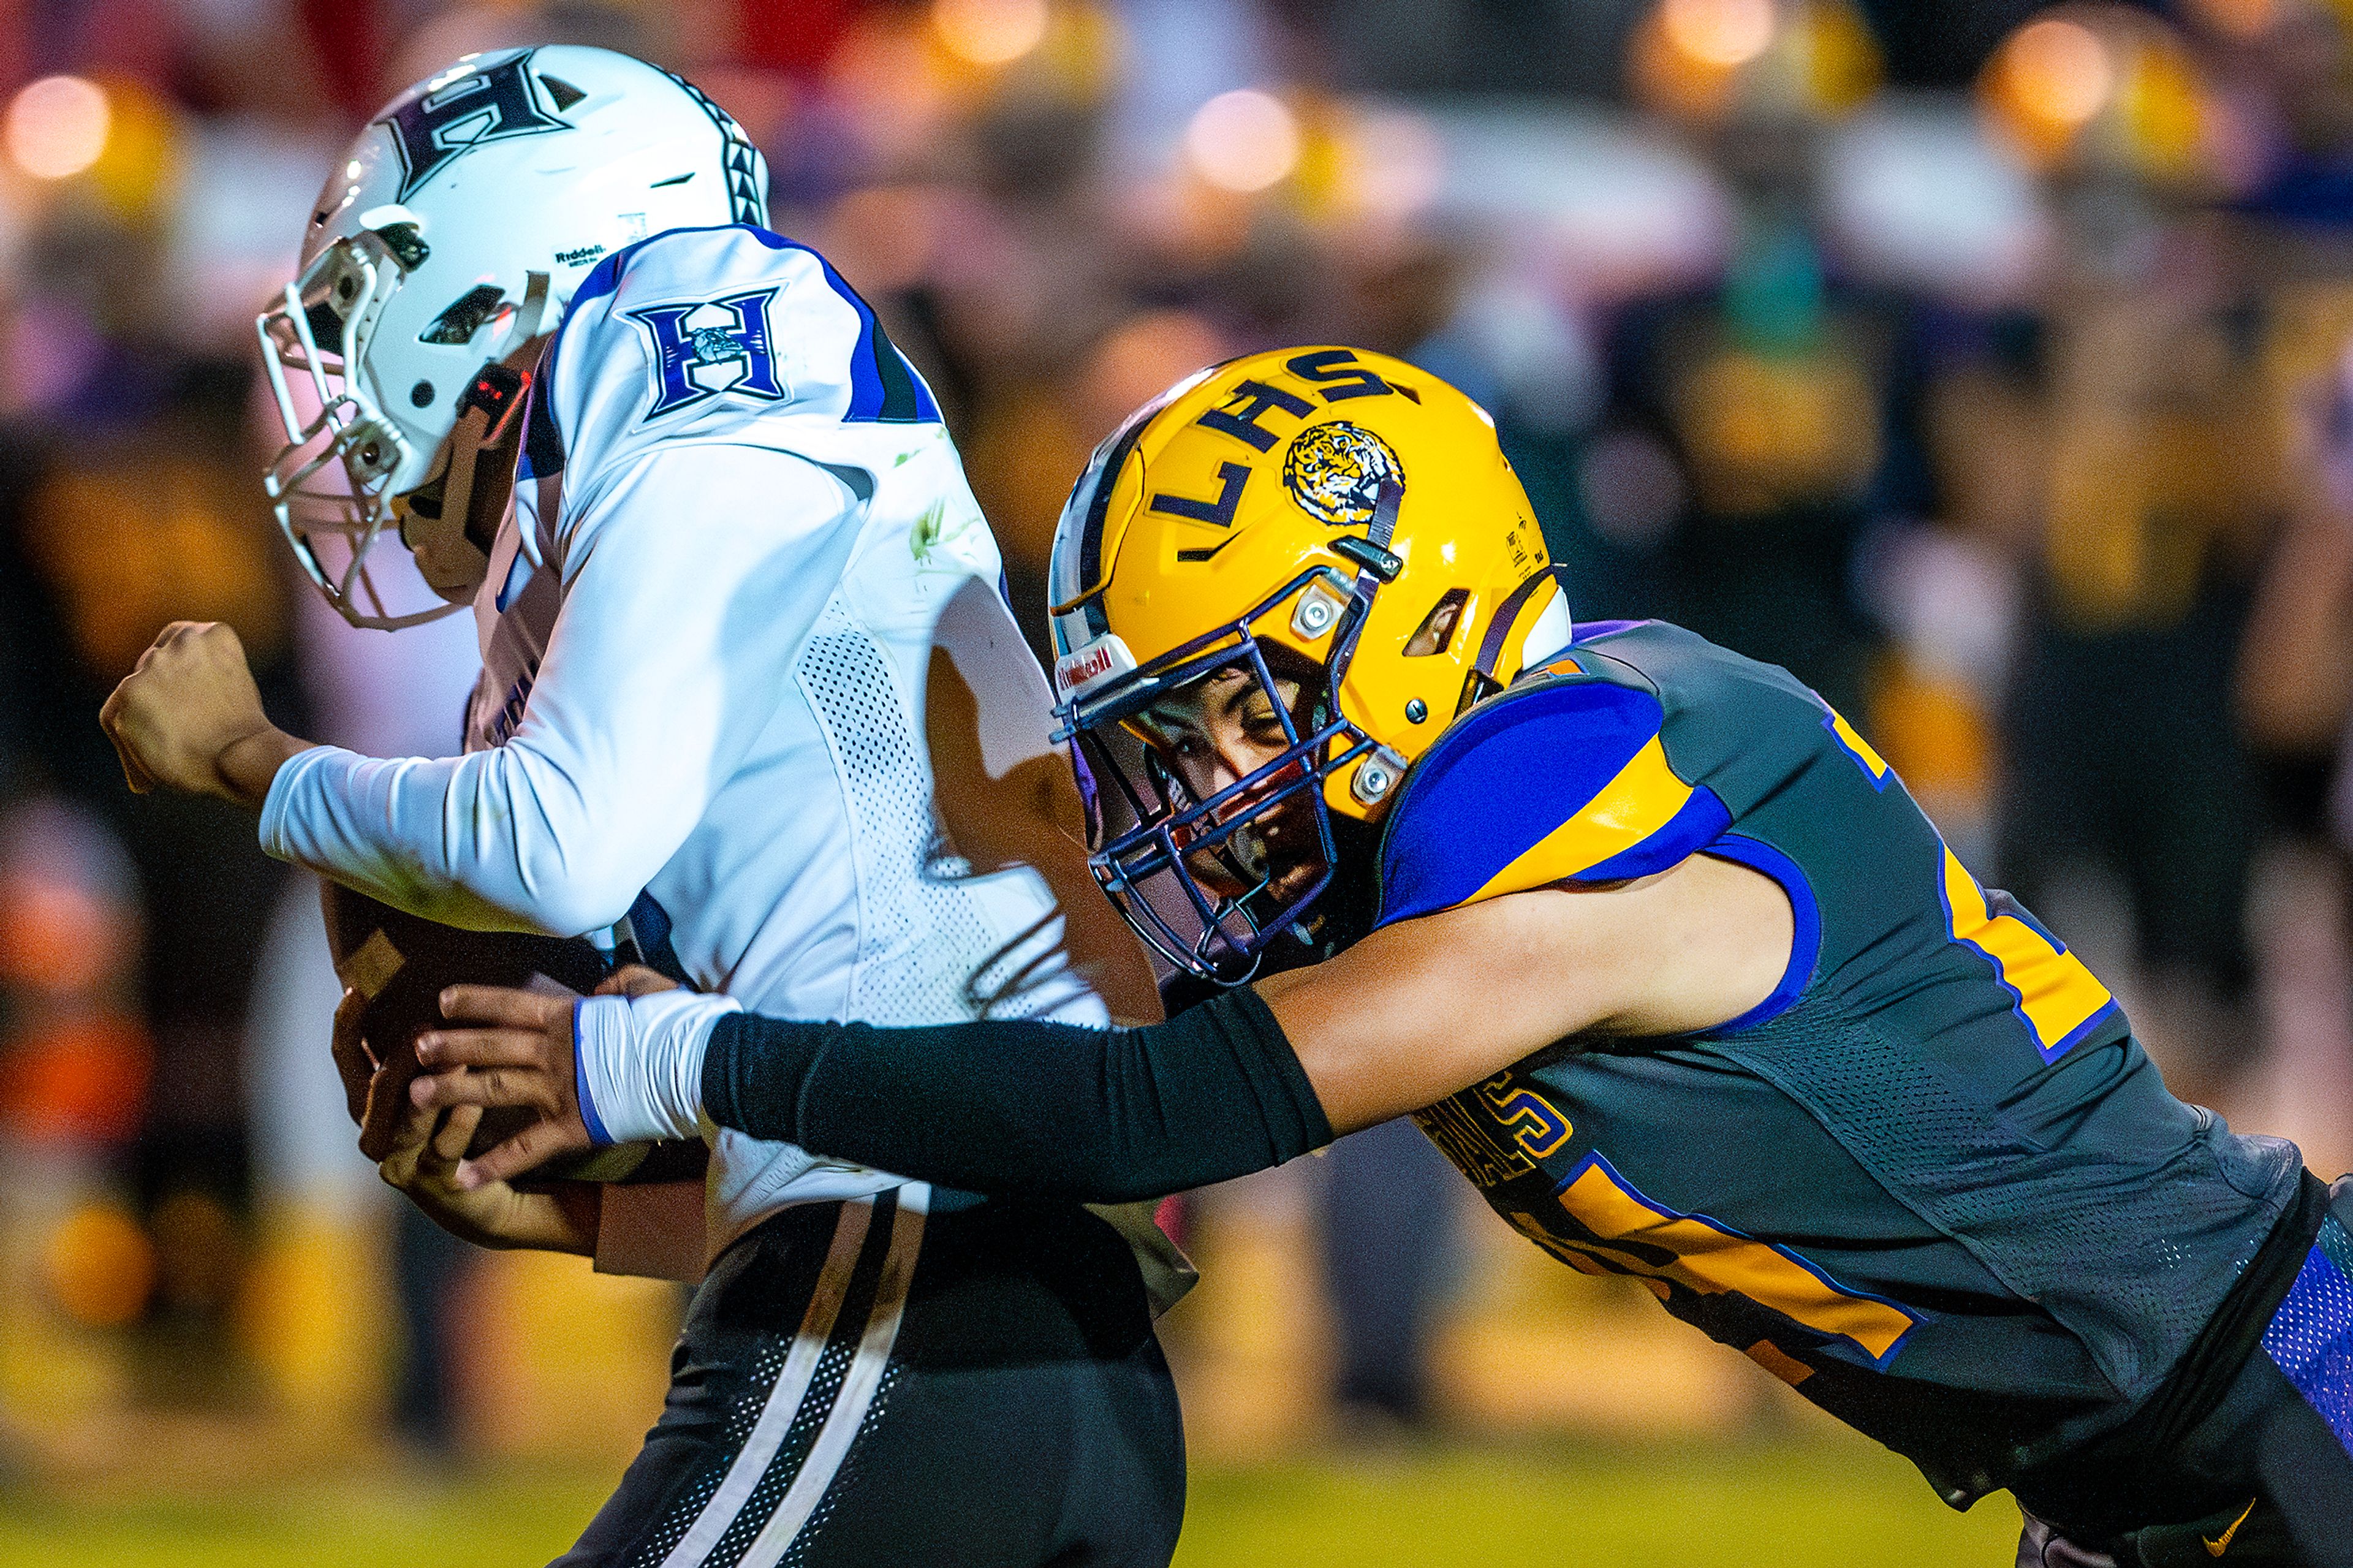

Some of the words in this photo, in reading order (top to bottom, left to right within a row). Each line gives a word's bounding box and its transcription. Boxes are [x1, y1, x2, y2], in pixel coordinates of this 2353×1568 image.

[371, 45, 575, 205] H
[555, 244, 606, 263] Riddell
[624, 284, 786, 424] H
[1149, 349, 1394, 529] LHS
